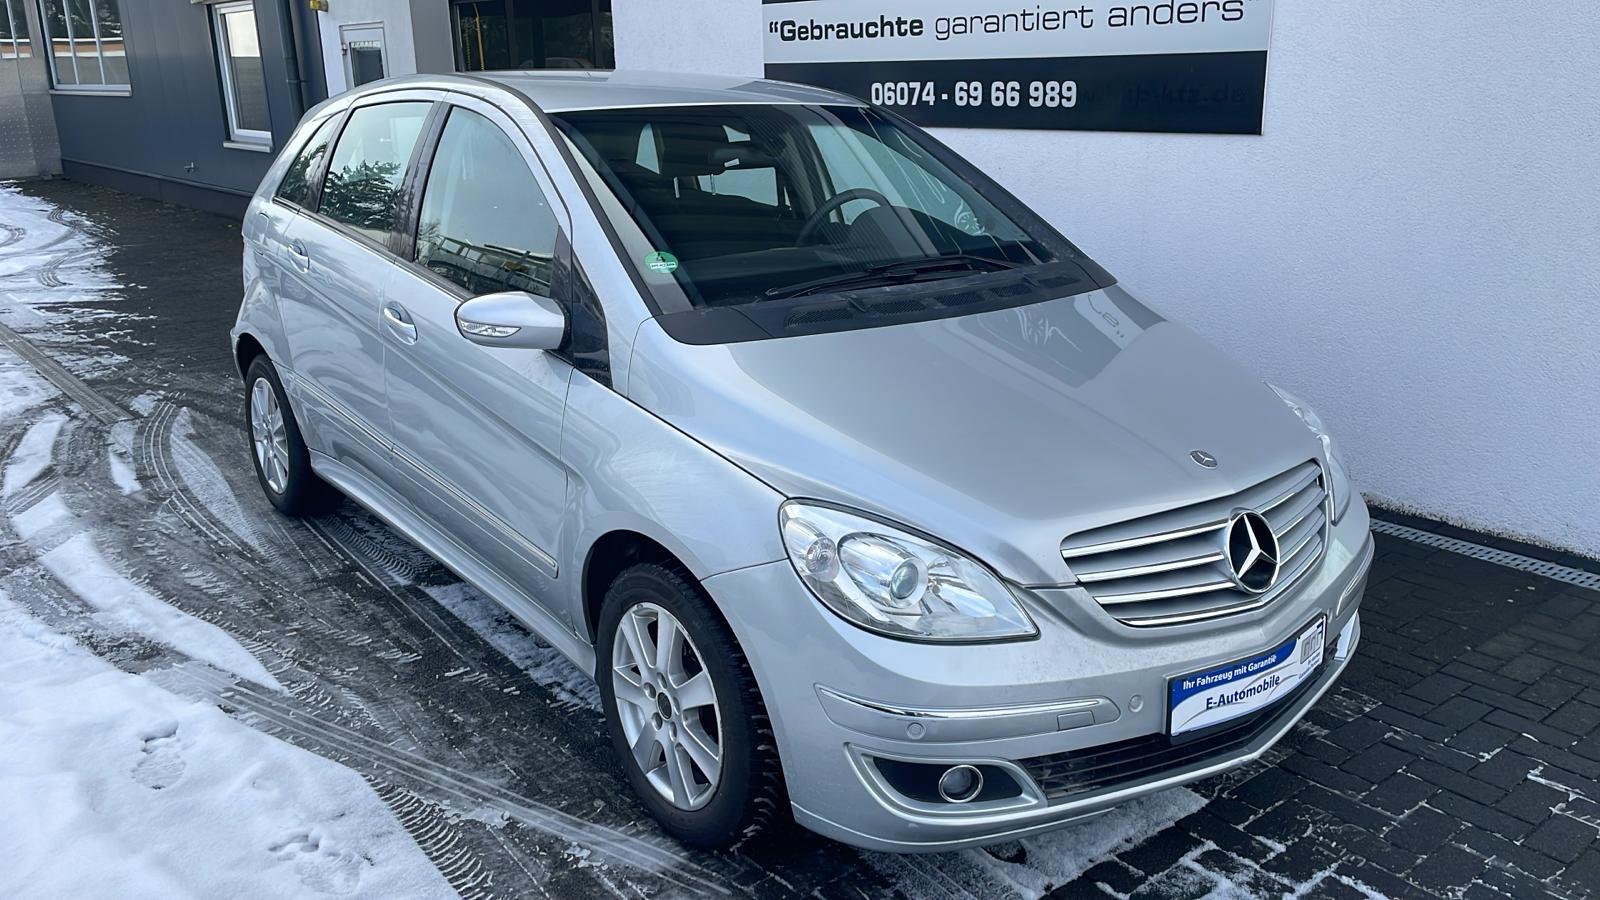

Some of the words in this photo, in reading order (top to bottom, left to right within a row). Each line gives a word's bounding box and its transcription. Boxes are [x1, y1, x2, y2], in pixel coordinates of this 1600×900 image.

[935, 5, 1094, 41] garantiert
[1108, 0, 1261, 28] anders
[871, 82, 936, 106] 06074
[954, 81, 983, 107] 69
[990, 81, 1020, 107] 66
[1028, 80, 1077, 108] 989
[1183, 680, 1196, 690] Ihr
[1196, 671, 1233, 687] Fahrzeug
[1234, 665, 1248, 677] mit
[1247, 654, 1277, 672] Garantie
[1205, 674, 1280, 710] E-Automobile
